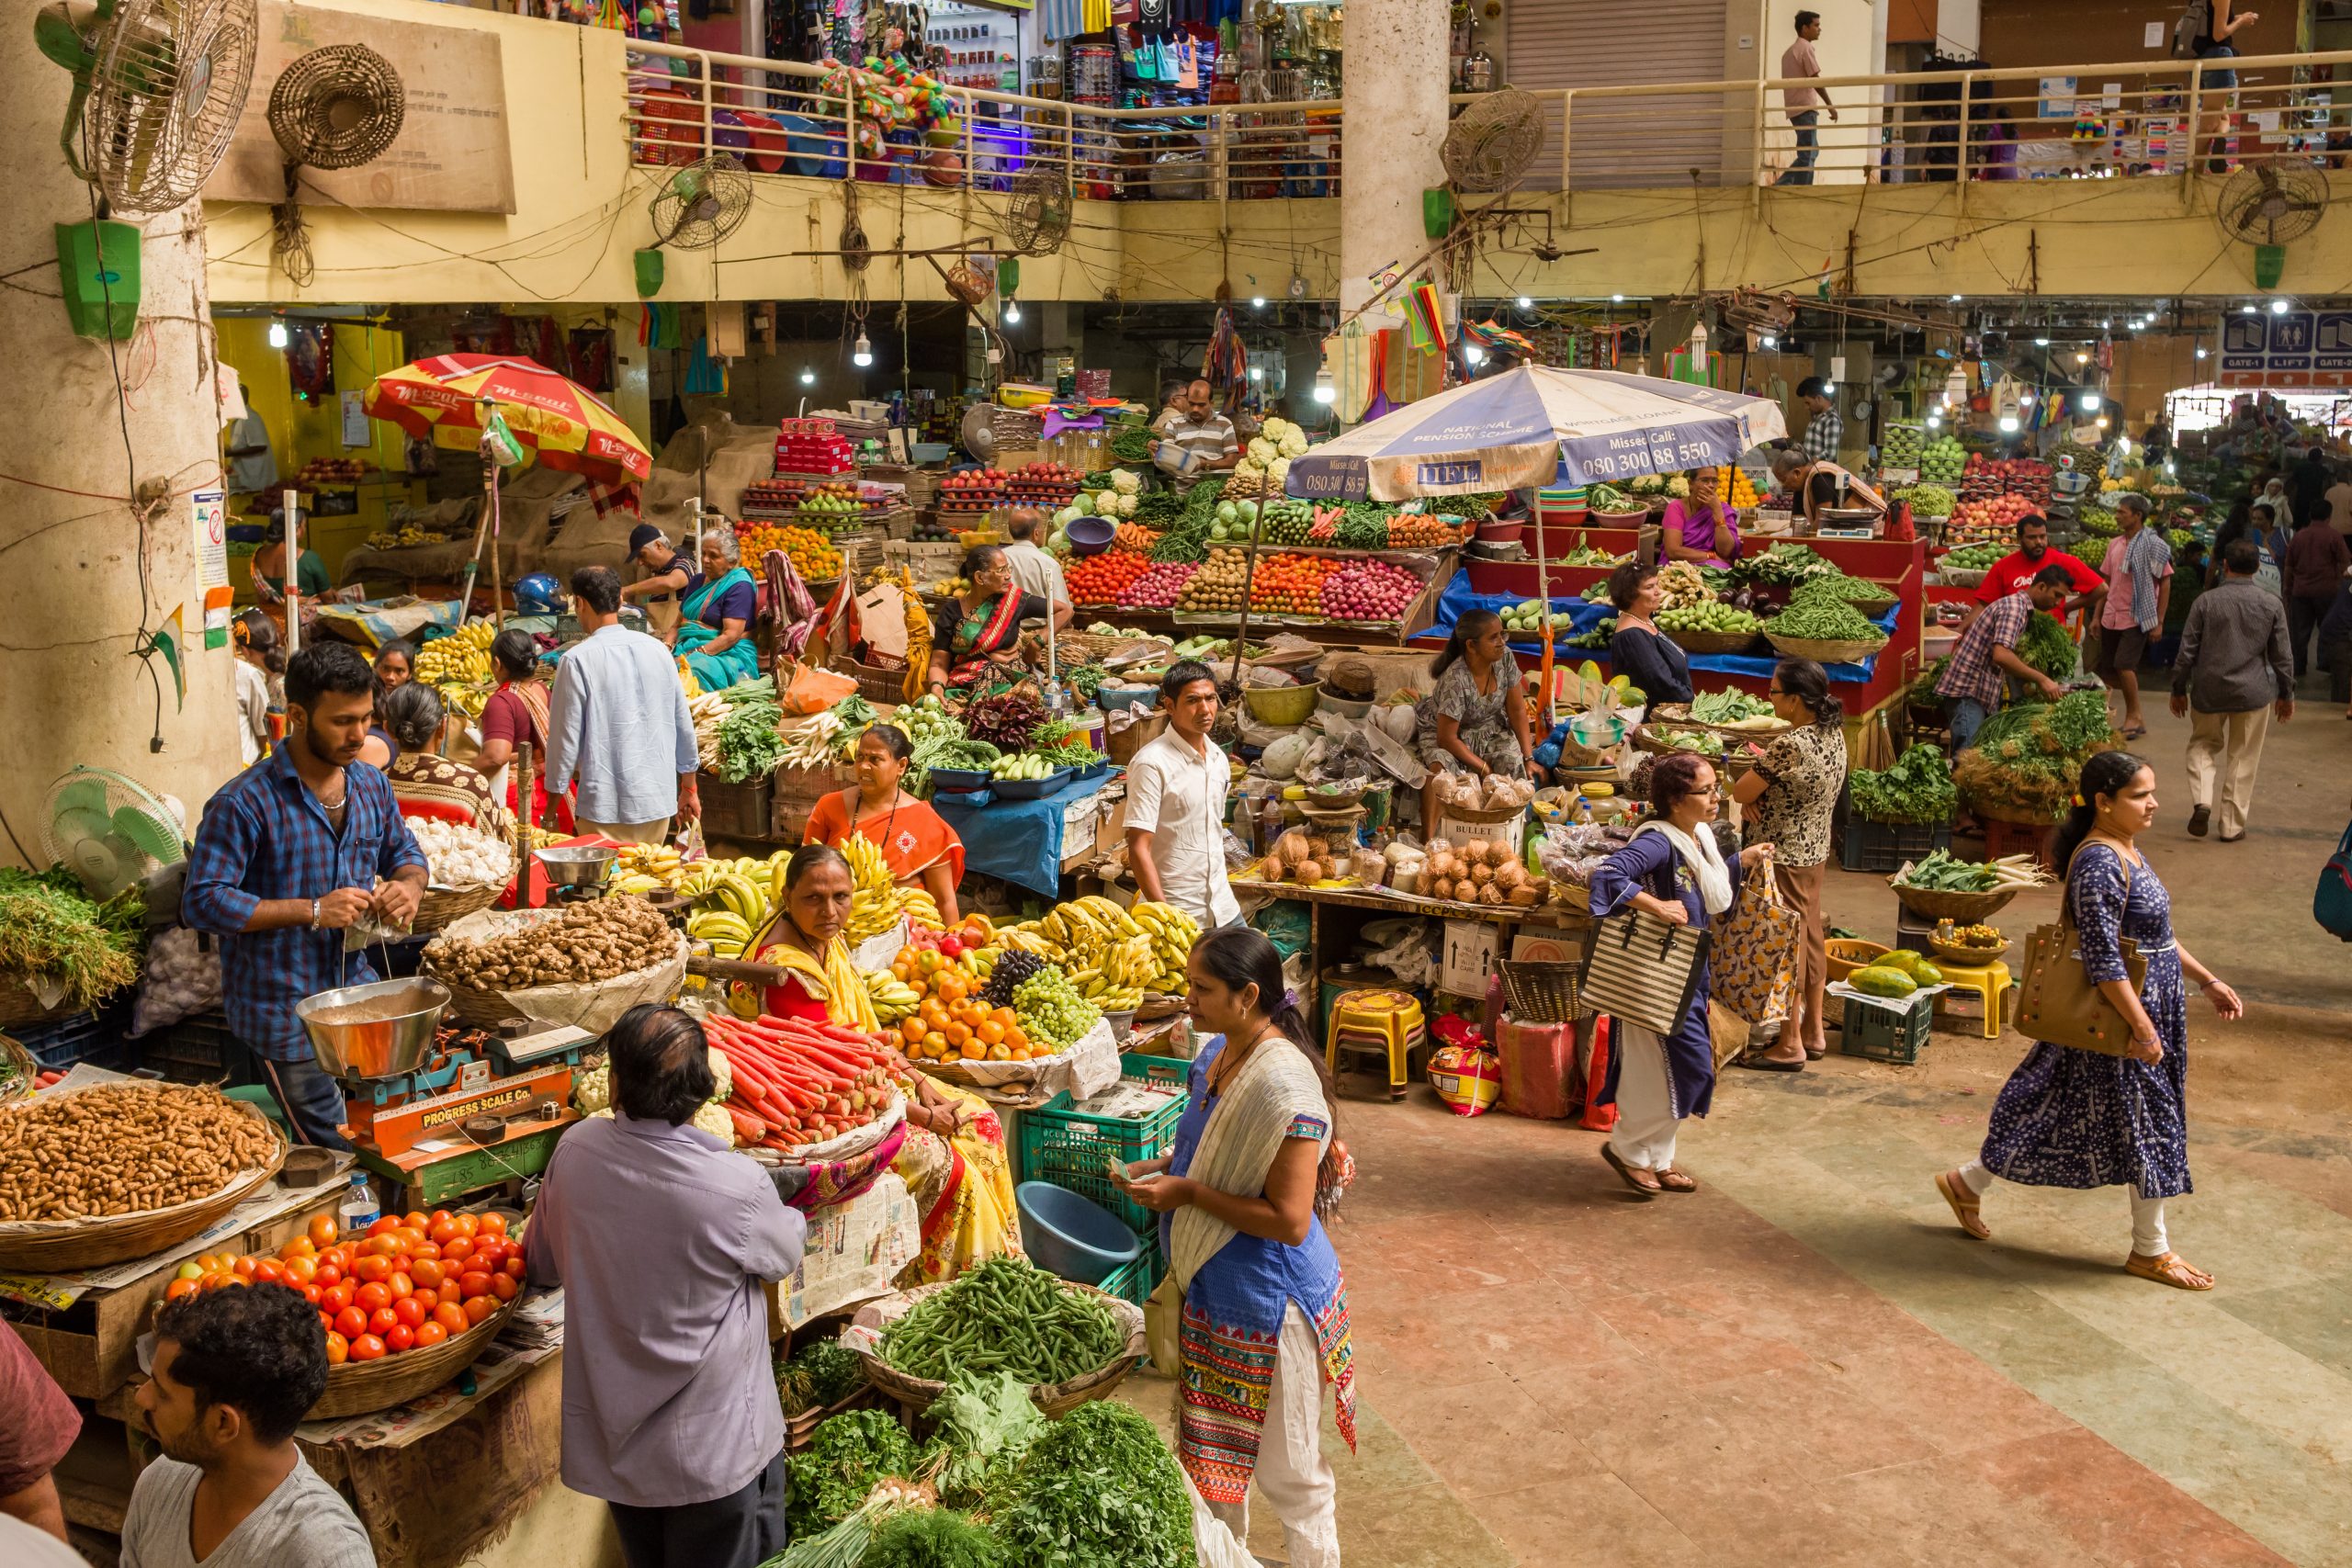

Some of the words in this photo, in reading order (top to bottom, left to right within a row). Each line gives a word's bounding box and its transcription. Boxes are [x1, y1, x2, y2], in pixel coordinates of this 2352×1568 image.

[2228, 358, 2259, 367] GATE-1
[2274, 358, 2305, 367] LIFT
[2320, 358, 2352, 367] GATE-2
[1413, 433, 1473, 441] PENSION
[1650, 430, 1676, 444] Call:
[1583, 457, 1614, 478] 080
[1619, 451, 1649, 471] 300
[1655, 448, 1675, 466] 88
[1679, 442, 1712, 461] 550
[1422, 462, 1478, 483] IIFL
[1306, 475, 1328, 491] 080
[1345, 476, 1356, 492] 88
[1455, 825, 1493, 836] BULLET
[424, 1102, 479, 1127] PROGRESS
[481, 1091, 513, 1109] SCALE
[514, 1089, 531, 1101] Co.
